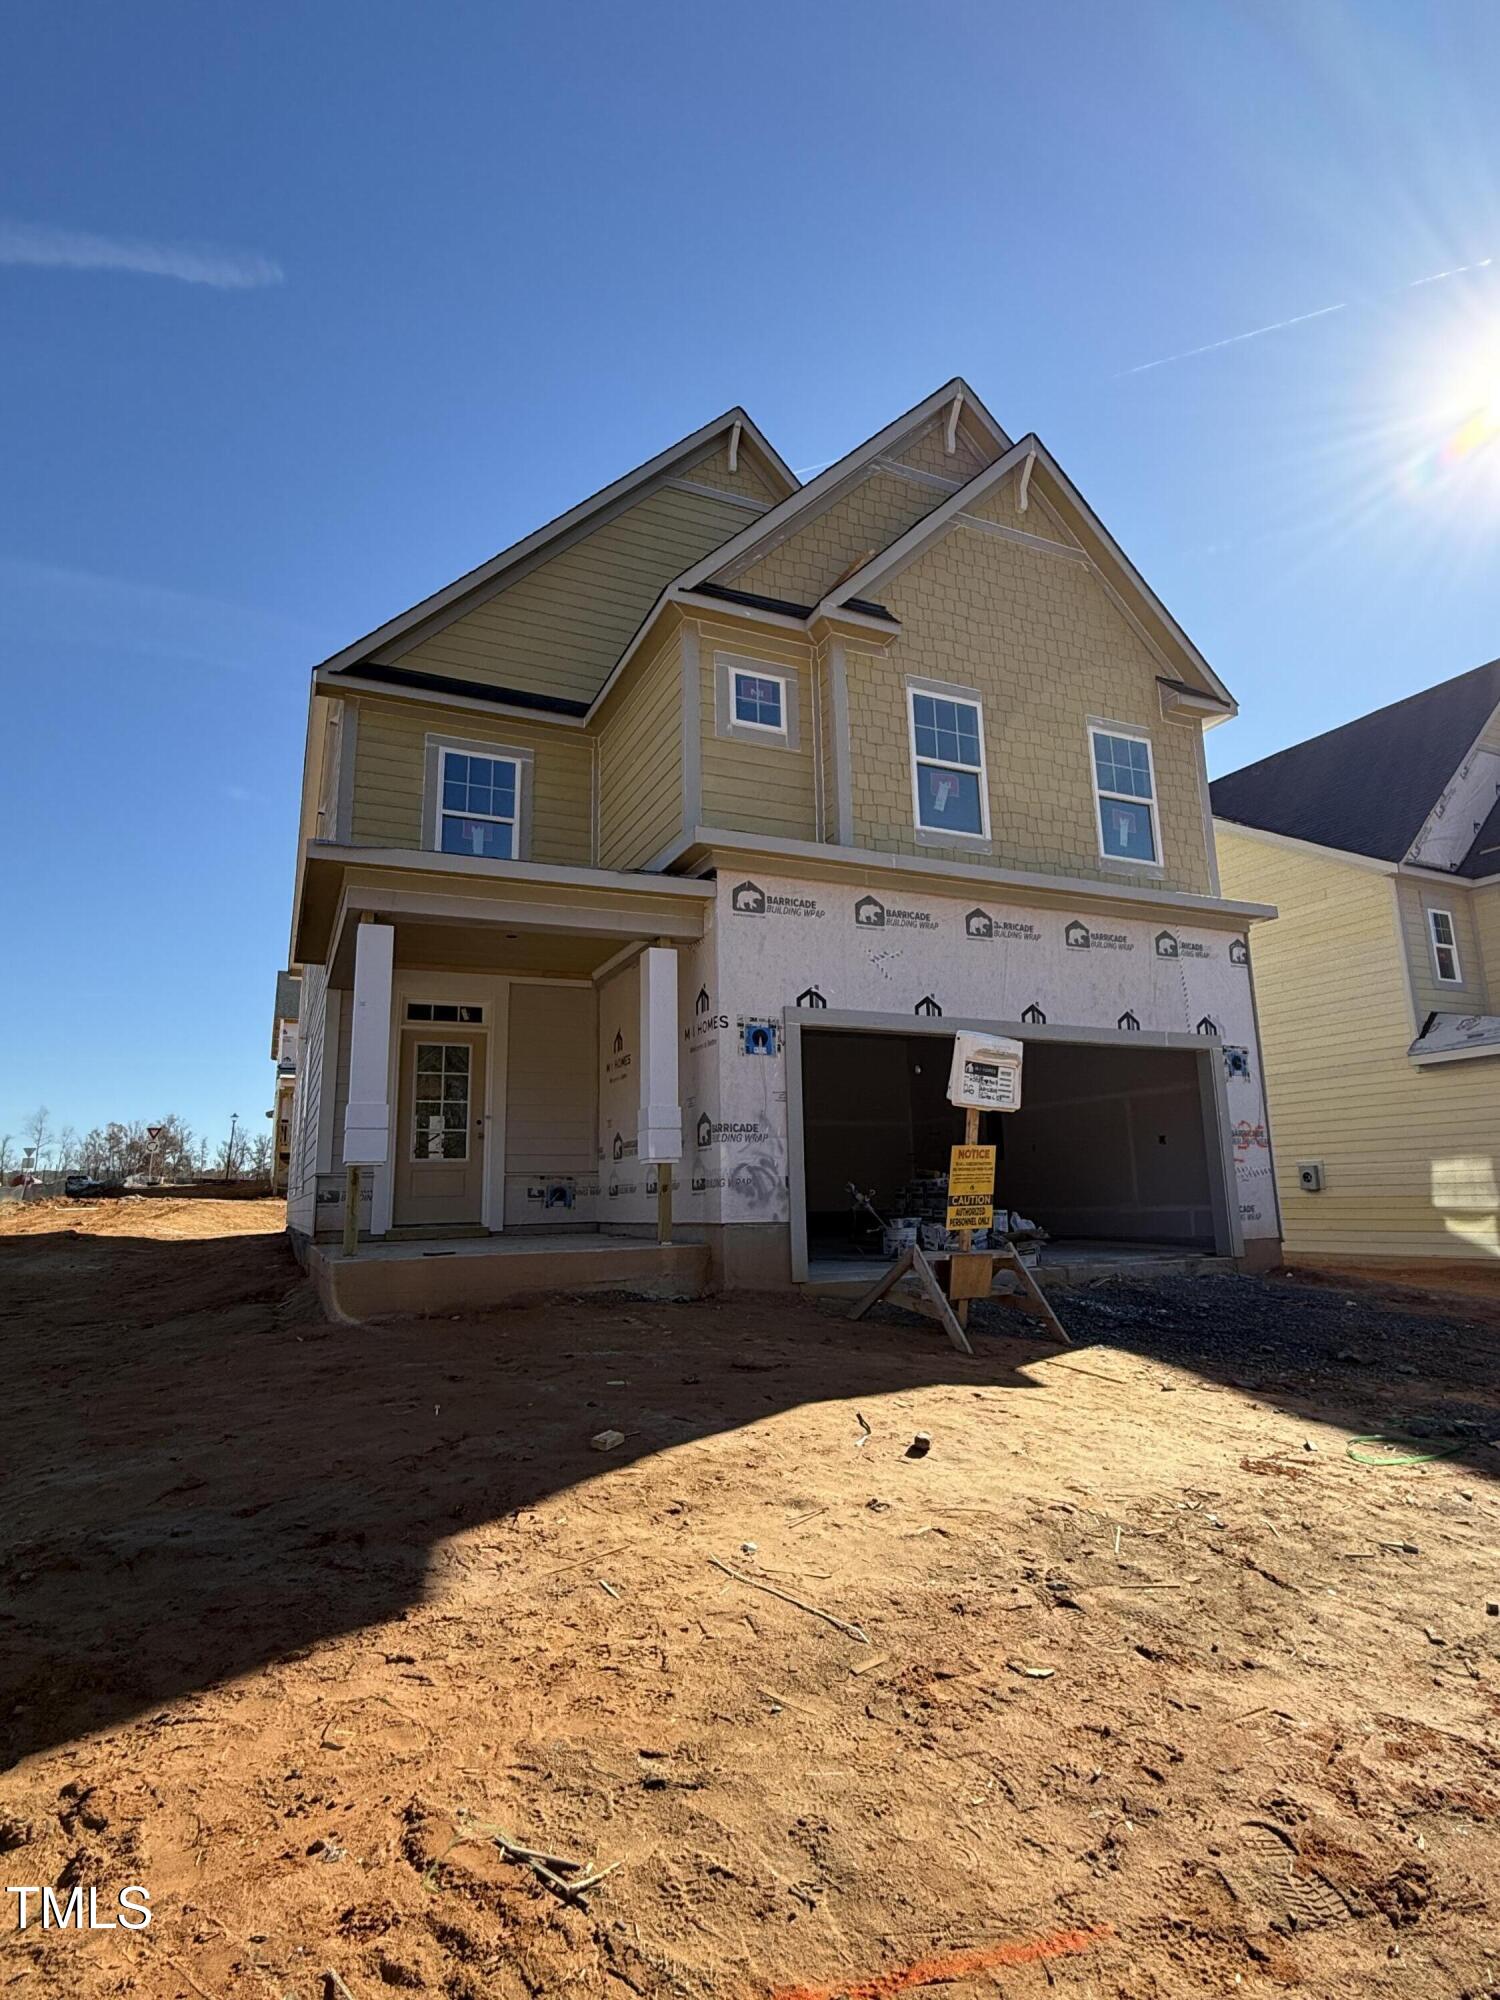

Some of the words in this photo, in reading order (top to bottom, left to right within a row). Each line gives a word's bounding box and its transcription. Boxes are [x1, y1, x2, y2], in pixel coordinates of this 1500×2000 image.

[766, 895, 817, 909] BARRICADE
[766, 905, 801, 918] BUILDING
[803, 909, 826, 919] WRAP
[886, 909, 931, 921] BARRICADE
[886, 918, 918, 929] BUILDING
[919, 921, 939, 931] WRAP
[993, 930, 1022, 940] BUILDING
[1023, 933, 1042, 942] WRAP
[1090, 941, 1117, 950] BUILDING
[1118, 943, 1135, 951] WRAP
[697, 1015, 729, 1034] HOMES
[614, 1054, 632, 1069] HOMES
[744, 1133, 769, 1143] WRAP
[958, 1149, 990, 1160] NOTICE
[951, 1195, 991, 1206] CAUTION
[956, 1207, 986, 1217] AUTHORIZED
[949, 1217, 977, 1226] PERSONNEL
[977, 1217, 990, 1225] ONLY
